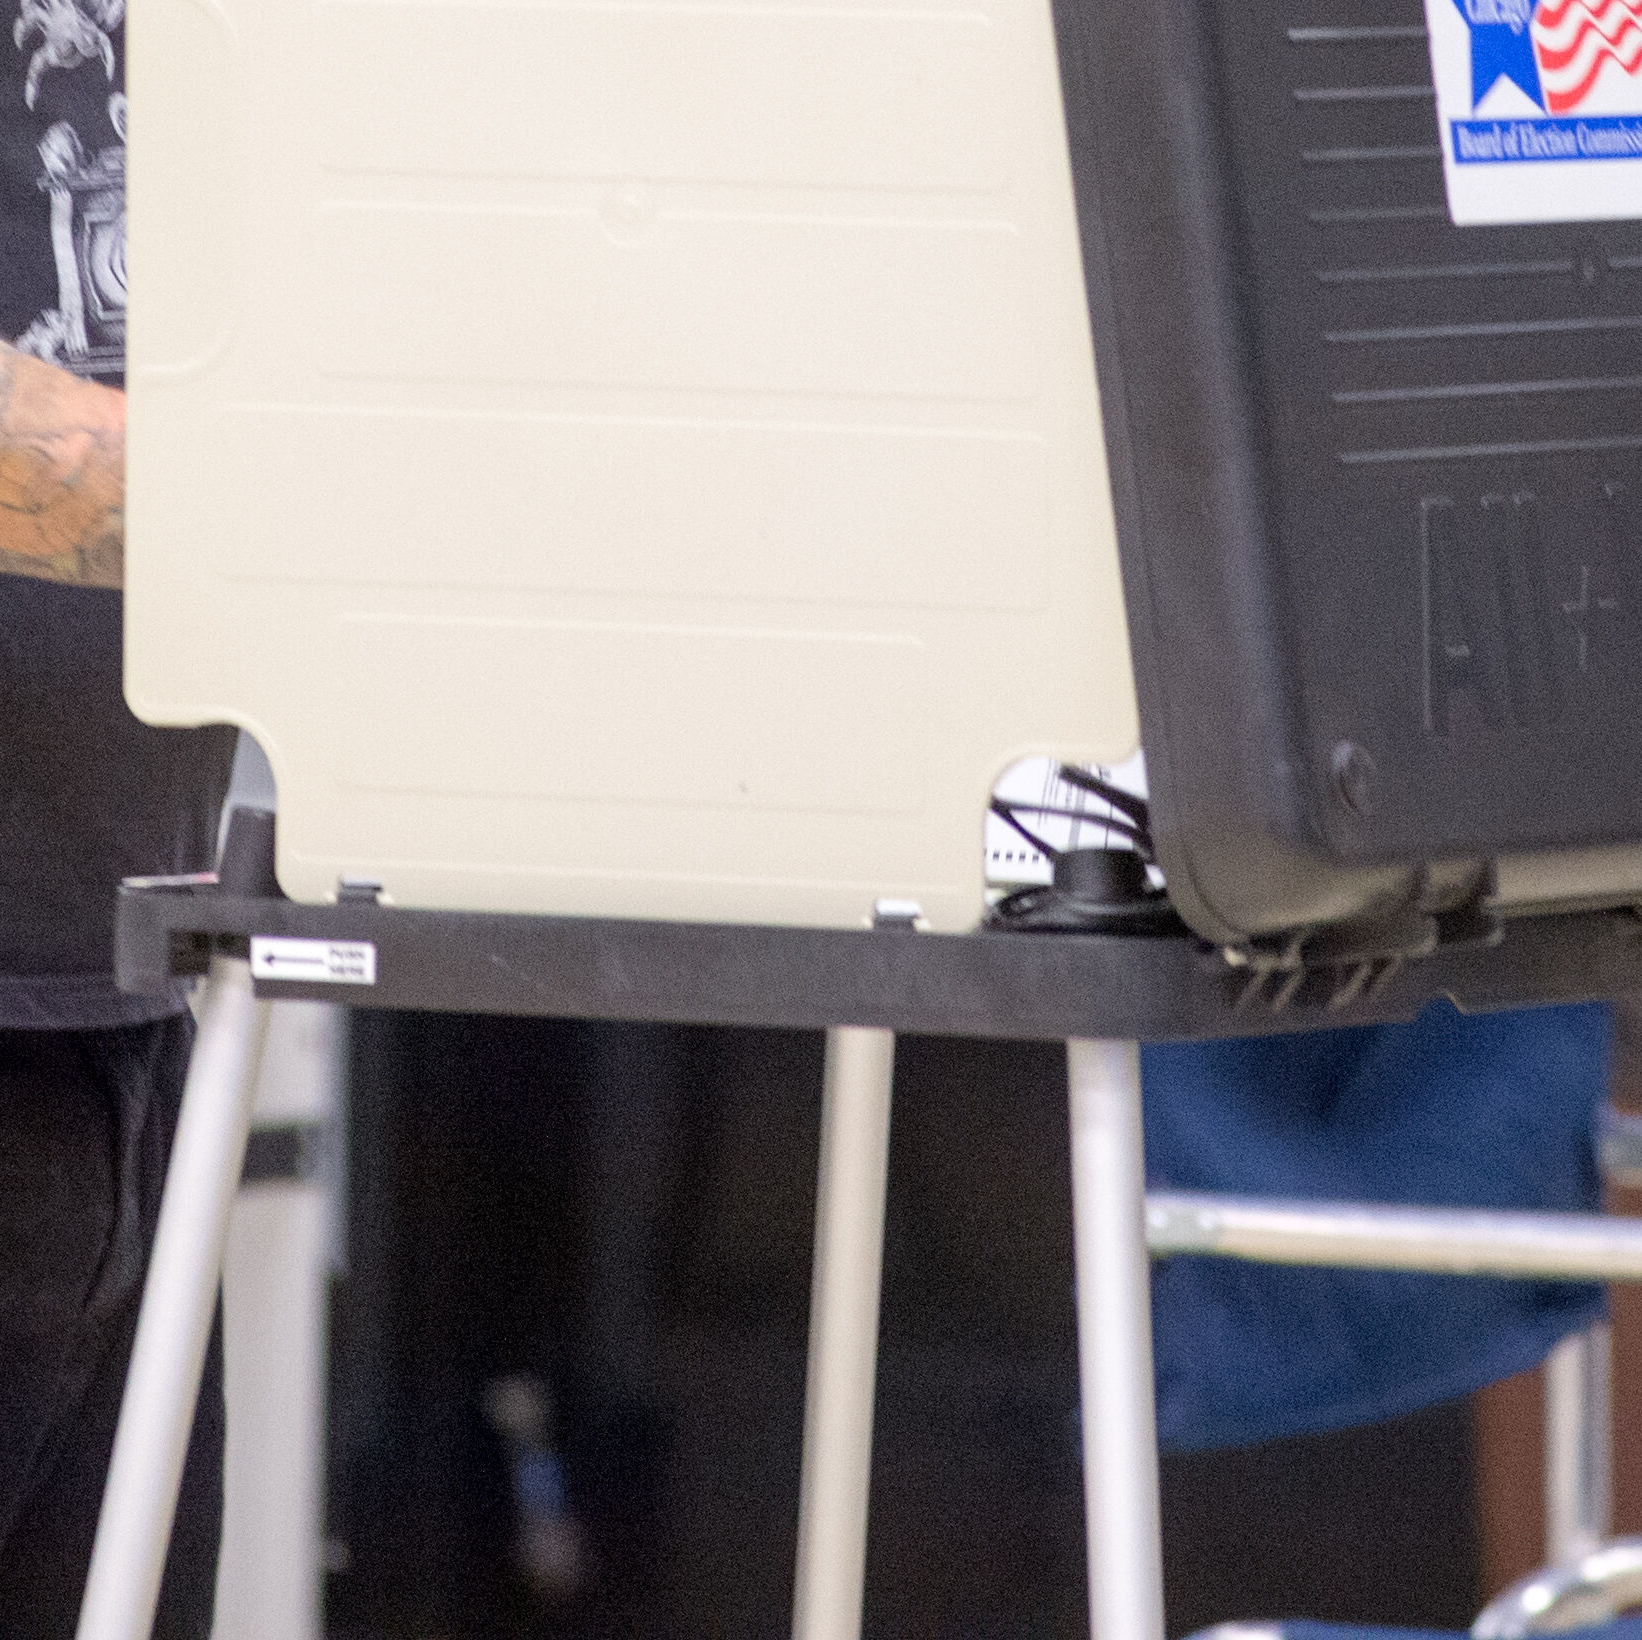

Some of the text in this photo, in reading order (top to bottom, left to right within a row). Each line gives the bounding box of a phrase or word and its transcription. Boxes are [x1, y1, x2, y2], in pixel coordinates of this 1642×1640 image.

[1457, 123, 1504, 159] Board
[1503, 121, 1521, 158] of
[1519, 121, 1578, 158] Election
